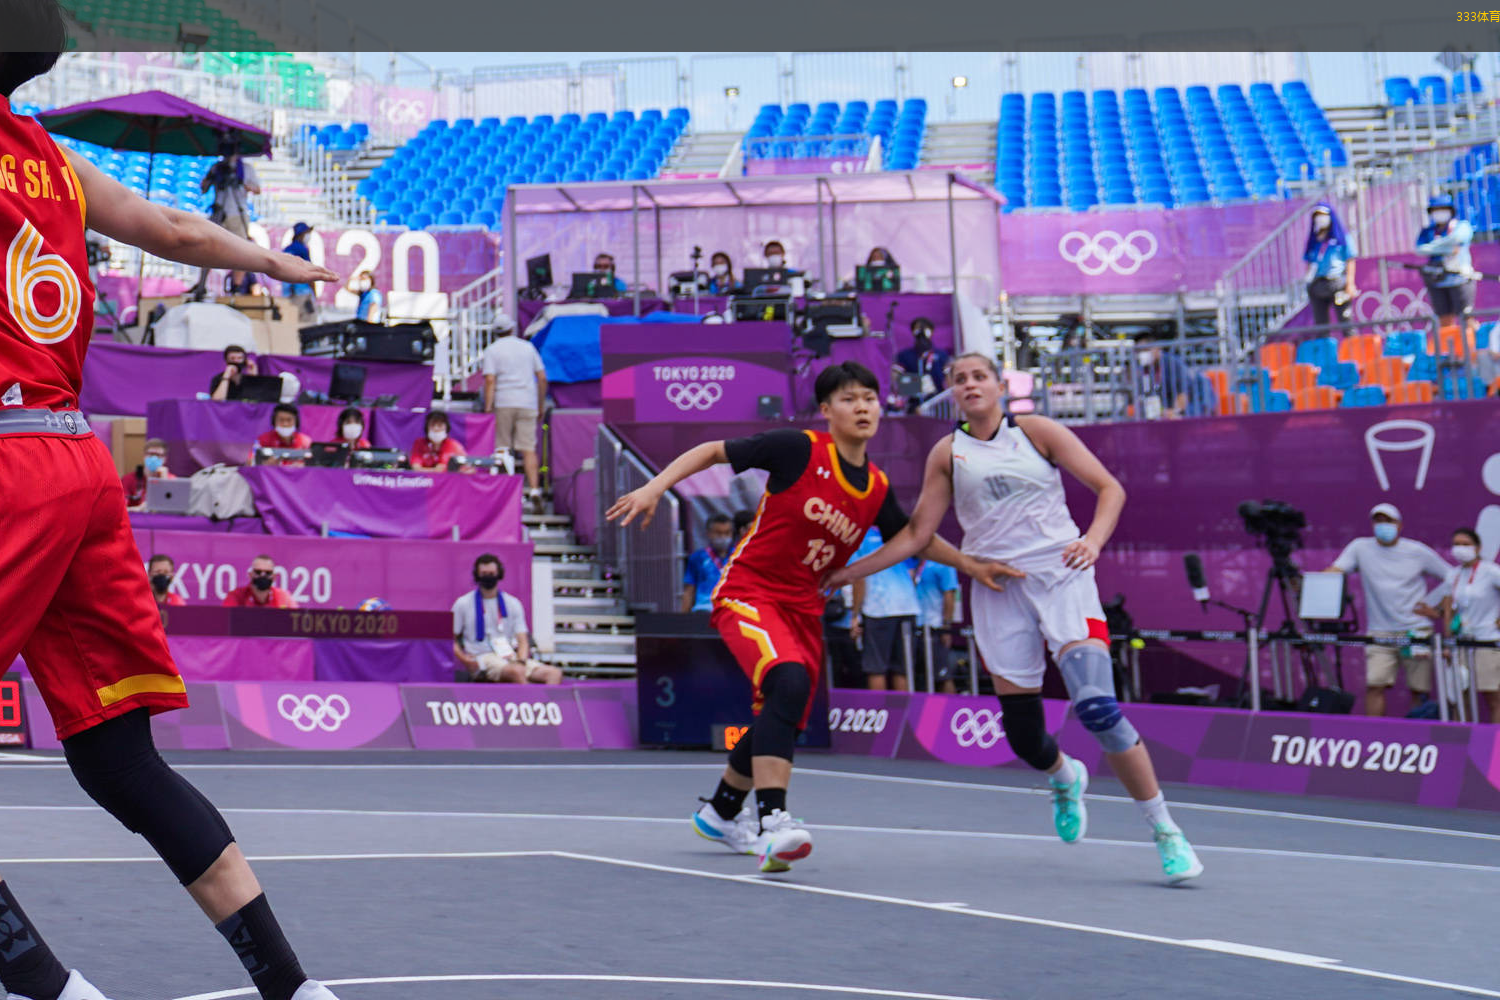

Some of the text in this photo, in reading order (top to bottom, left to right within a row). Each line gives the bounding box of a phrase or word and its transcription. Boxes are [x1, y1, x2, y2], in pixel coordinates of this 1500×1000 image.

[6, 218, 82, 345] 6
[653, 366, 736, 381] TOKYO 2020
[803, 497, 863, 547] CHINA
[802, 538, 835, 572] 13
[291, 612, 398, 634] TOKYO 2020
[655, 676, 676, 707] 3
[426, 701, 563, 726] TOKYO 2020
[840, 708, 889, 733] 2020
[1271, 734, 1439, 775] TOKYO 2020
